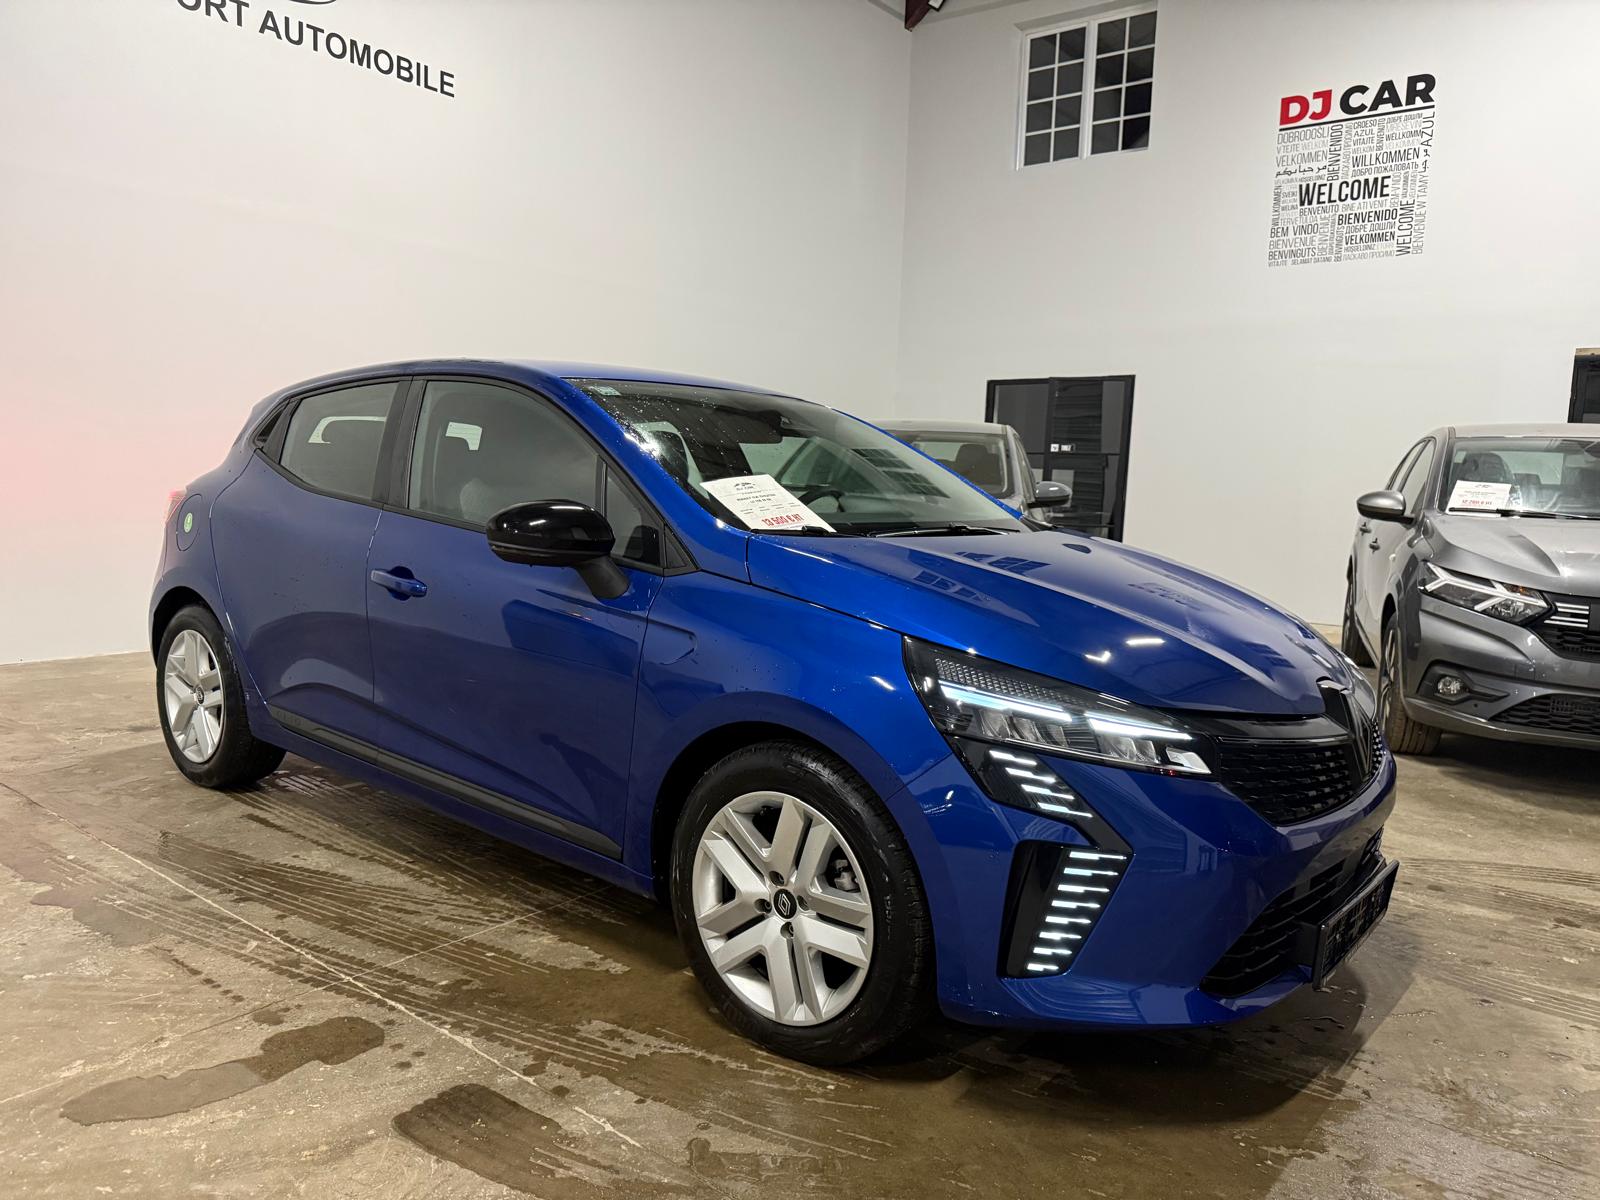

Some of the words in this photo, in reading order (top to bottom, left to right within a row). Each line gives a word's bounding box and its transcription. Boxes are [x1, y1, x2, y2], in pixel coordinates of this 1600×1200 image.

[258, 10, 455, 98] AUTOMOBILE
[1279, 89, 1332, 126] DJ
[1339, 73, 1436, 115] CAR
[1353, 119, 1377, 130] CROESO
[1421, 111, 1435, 147] AZUL
[1352, 136, 1375, 146] VITAJTE
[1353, 129, 1375, 138] AZUL
[1276, 150, 1328, 168] VELKOMMEN
[1327, 124, 1344, 181] BIENVENIDO
[1352, 147, 1420, 168] WILLKOMMEN
[1351, 166, 1373, 178] ДОБРО
[1374, 162, 1419, 175] ПОЖАЛОВАТЬ
[1299, 176, 1392, 207] WELCOME
[1271, 186, 1282, 228] WILLKOMMEN
[1300, 204, 1339, 216] BENVENUTO
[1338, 208, 1398, 226] BIENVENIDO
[1270, 226, 1289, 238] BEM
[1292, 223, 1319, 236] VINDO
[1344, 224, 1368, 234] ДОБРЕ
[1369, 221, 1396, 232] ДОШЛИ
[1396, 200, 1415, 256] WELCOME
[1268, 236, 1317, 250] BIENVENUE
[1344, 231, 1396, 246] VELKOMMEN
[1268, 247, 1316, 261] BENVINGUTS
